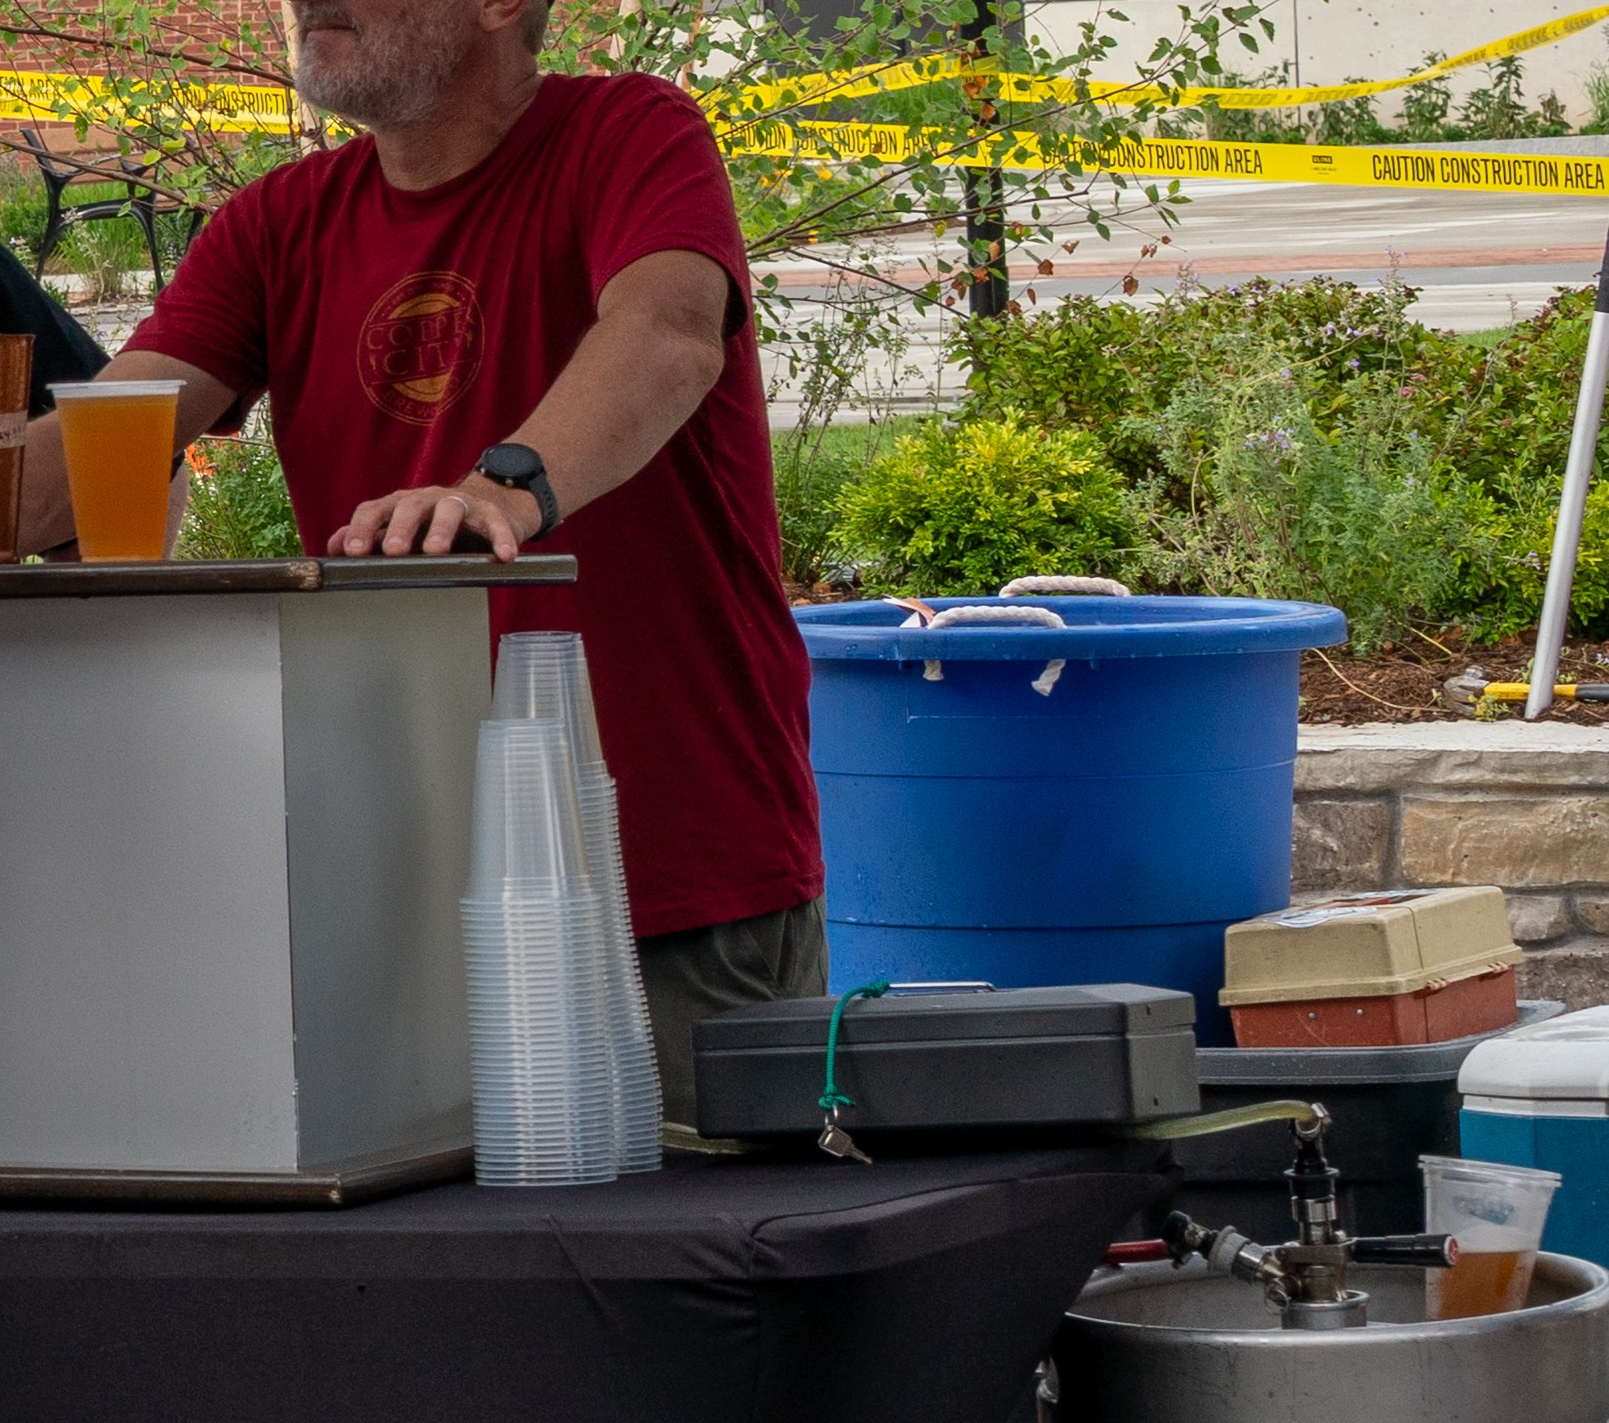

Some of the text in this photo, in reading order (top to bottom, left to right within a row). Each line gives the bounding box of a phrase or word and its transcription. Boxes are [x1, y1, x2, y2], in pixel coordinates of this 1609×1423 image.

[1224, 148, 1264, 175] AREA
[1372, 153, 1606, 190] CAUTION CONSTRUCTION AREA
